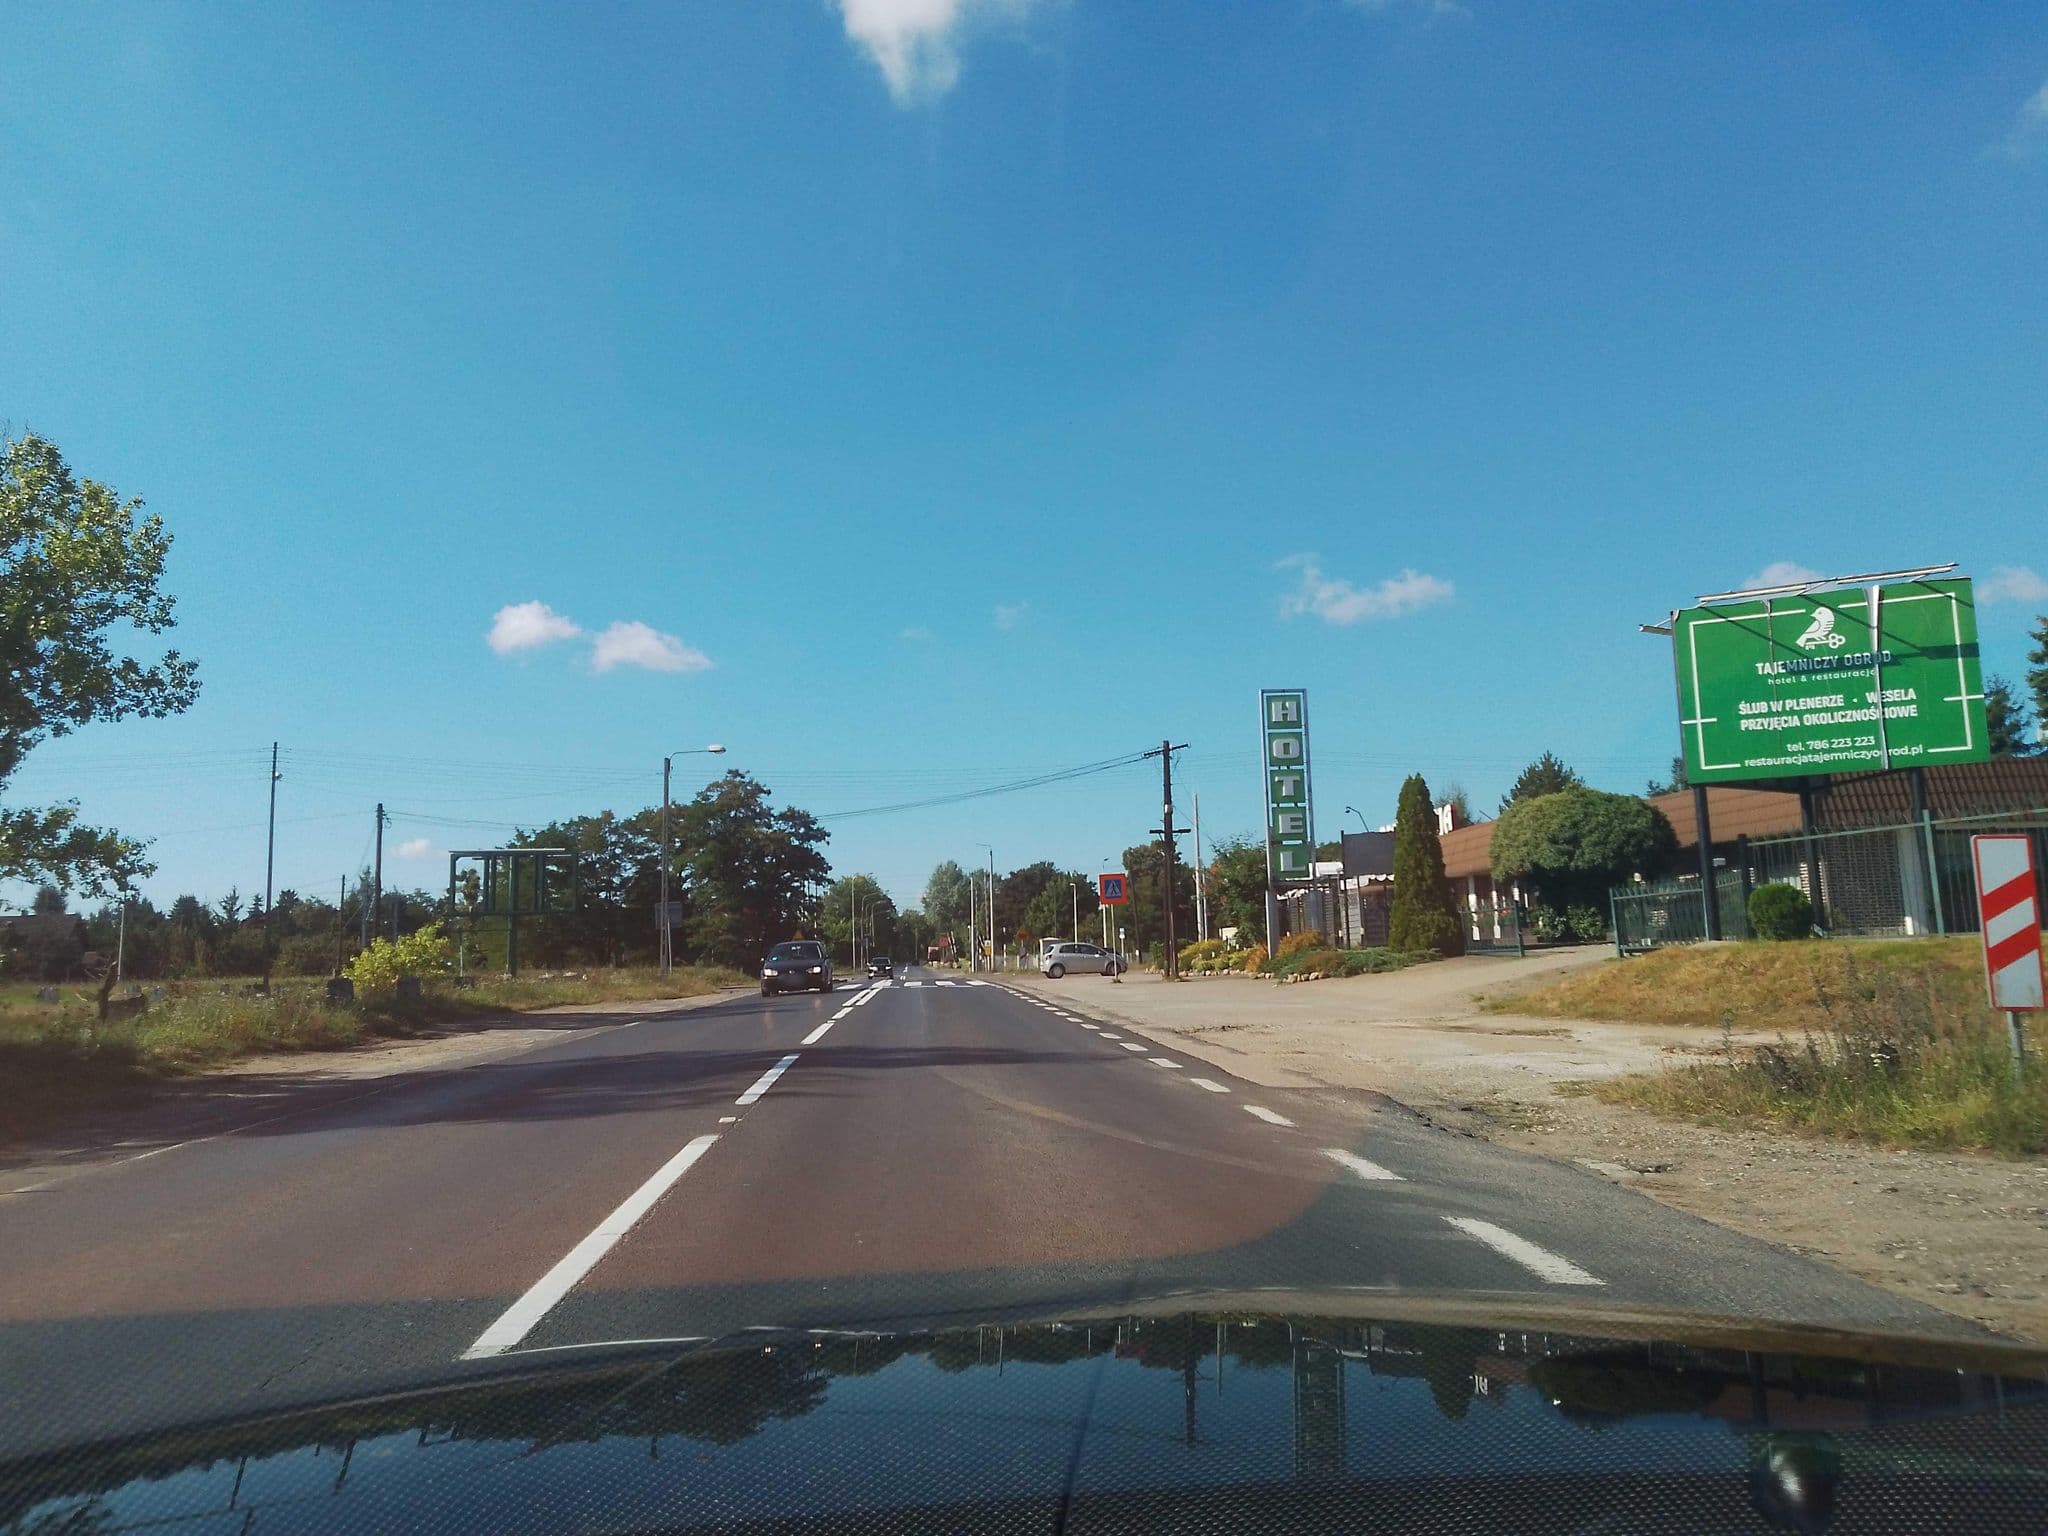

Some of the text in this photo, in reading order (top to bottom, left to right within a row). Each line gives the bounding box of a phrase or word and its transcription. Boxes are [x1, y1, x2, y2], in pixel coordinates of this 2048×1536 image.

[1755, 655, 1839, 675] TAJEMNICZY
[1768, 676, 1796, 685] hotel
[1738, 688, 1917, 715] ŚLUB W PLENERZE WESELA
[1740, 705, 1918, 731] PRZYJĘCIA OKOLICZNOŚIOWE
[1744, 744, 1923, 767] restauracjatajemniczyorod.pl
[1786, 736, 1875, 752] tel. 786 223 223
[1271, 701, 1306, 871] HOTEL
